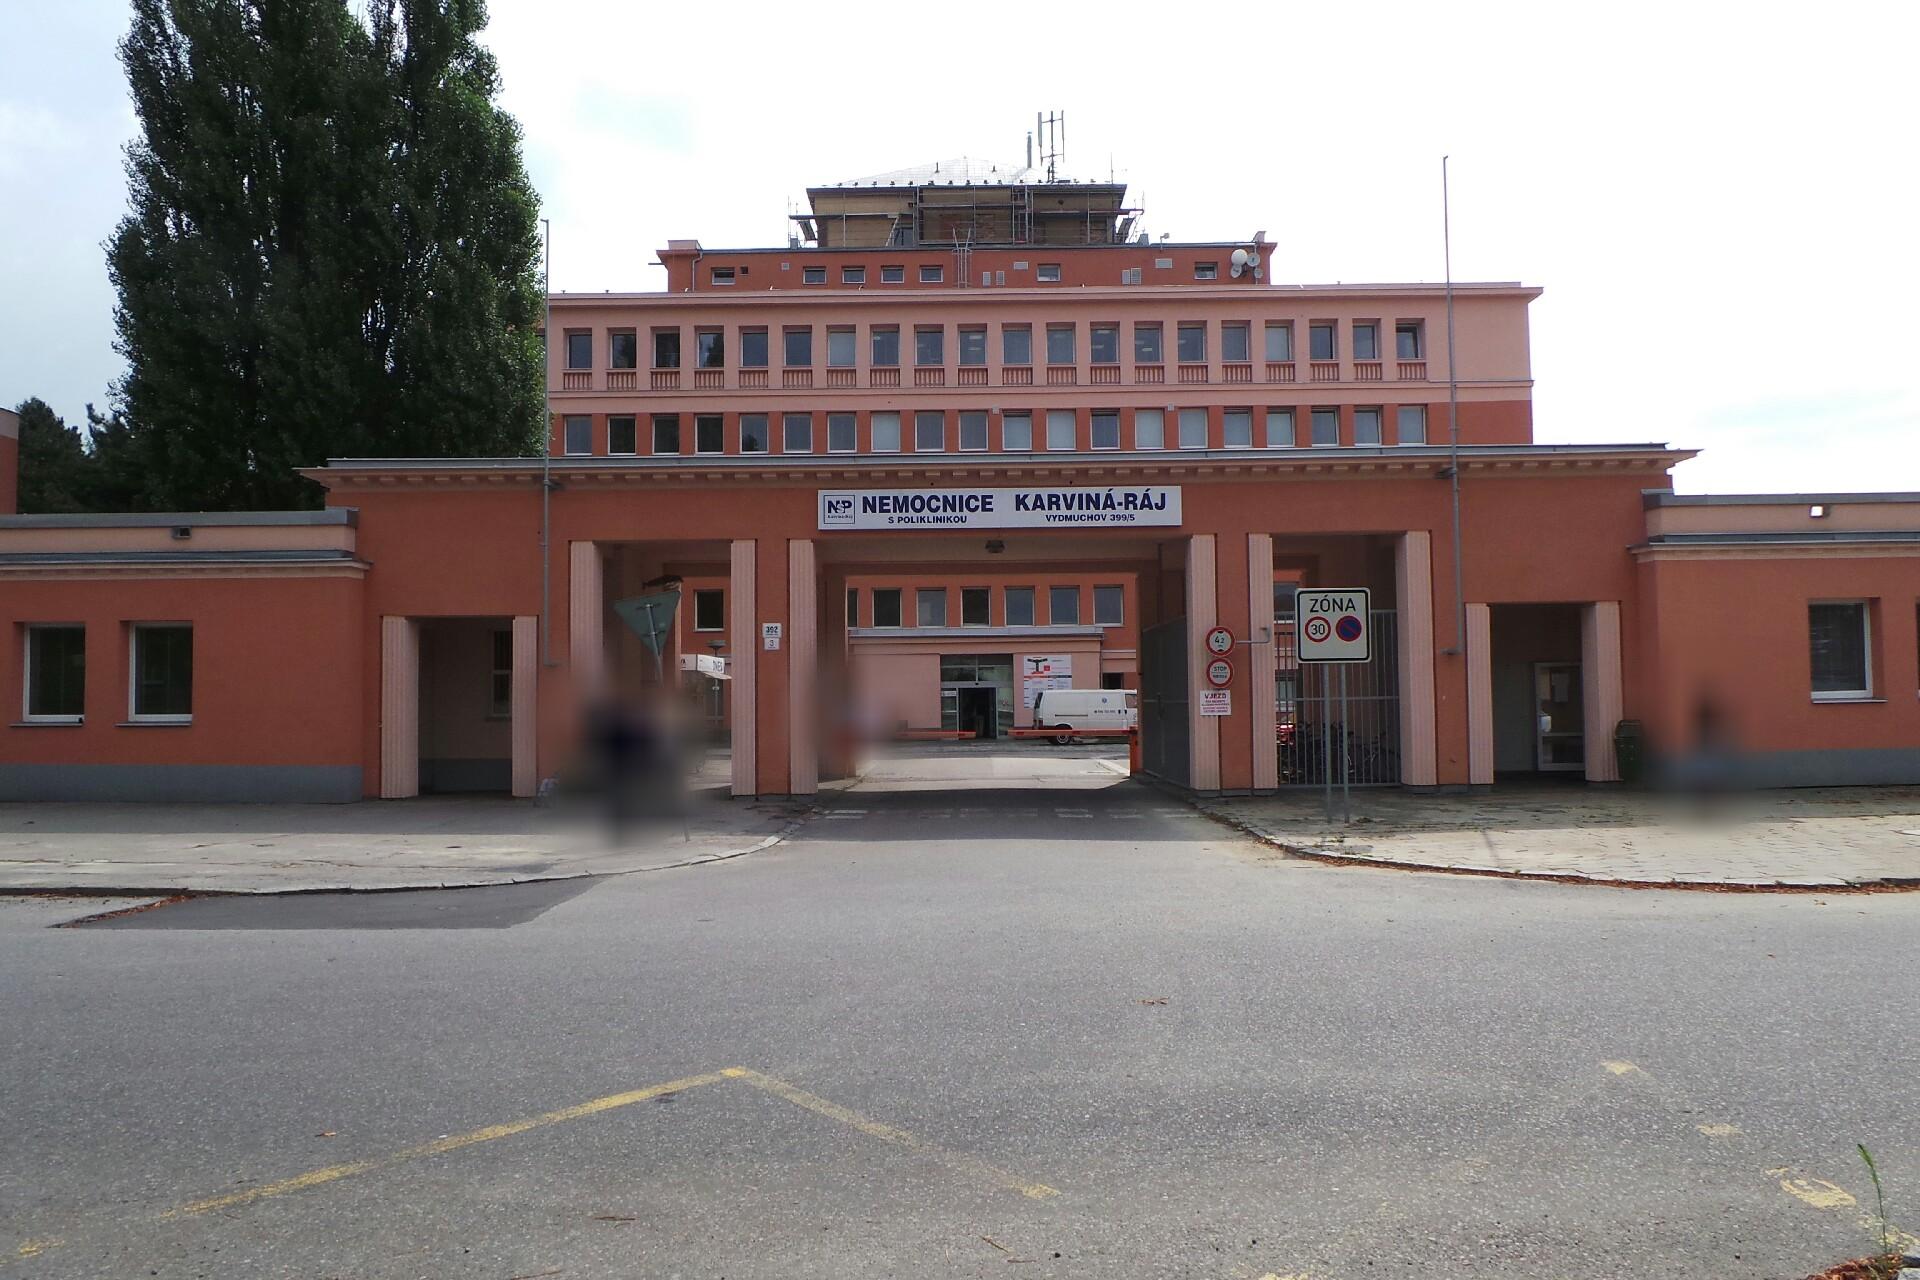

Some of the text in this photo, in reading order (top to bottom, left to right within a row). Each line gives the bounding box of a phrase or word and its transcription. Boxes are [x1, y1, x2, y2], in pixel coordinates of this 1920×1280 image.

[862, 488, 1166, 514] NEMOCNICE KARVINÁ-RÁJ
[888, 515, 967, 524] S POLIKLINIKOU
[1046, 513, 1135, 522] VYDMUCHOV 399/5
[1309, 594, 1356, 613] ZÓNA
[1310, 623, 1325, 635] 30
